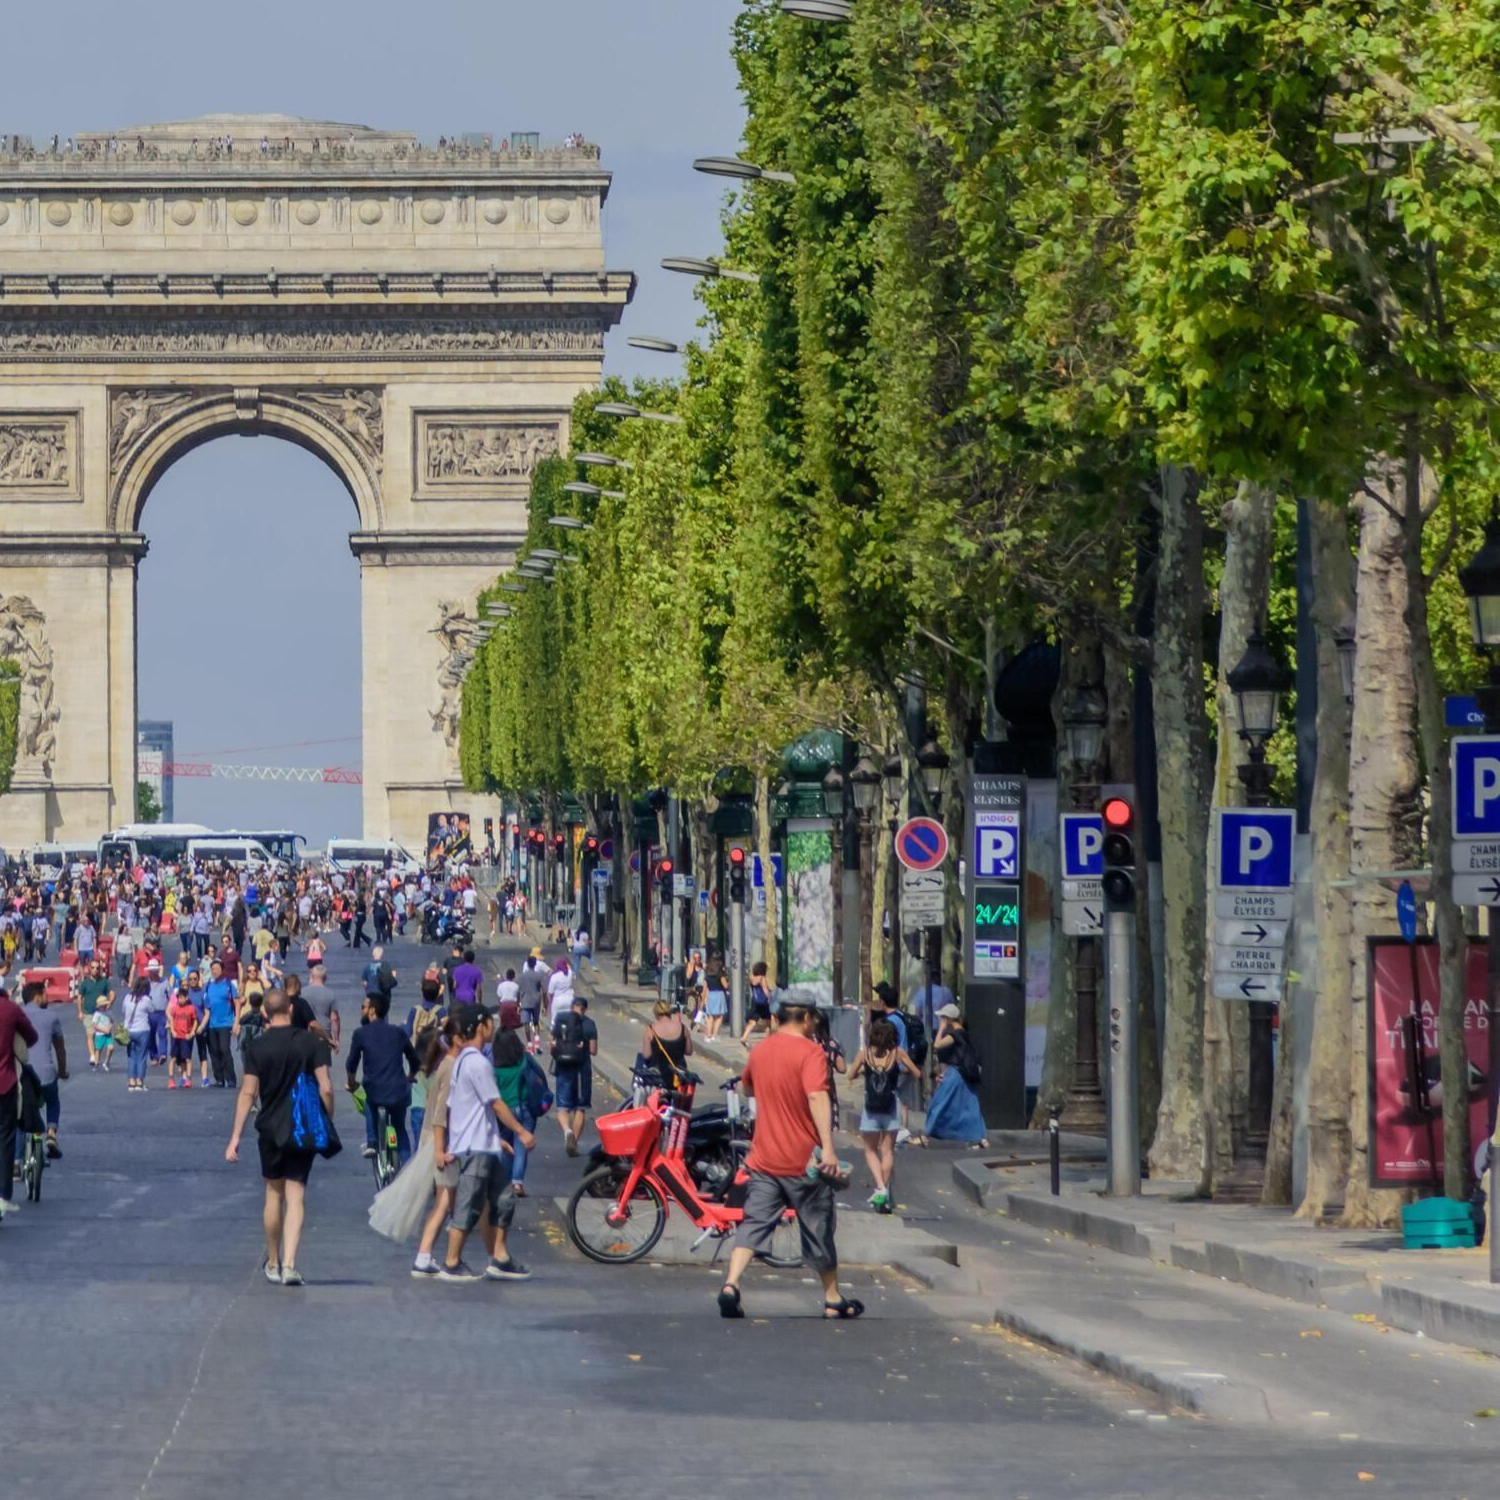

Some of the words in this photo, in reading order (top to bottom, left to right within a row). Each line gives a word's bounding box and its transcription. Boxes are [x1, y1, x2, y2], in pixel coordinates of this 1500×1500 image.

[973, 780, 1021, 790] CHAMPS
[1474, 757, 1500, 819] P
[980, 829, 1015, 875] P
[1077, 826, 1103, 867] P
[1239, 825, 1273, 875] P
[1235, 896, 1275, 906] CHAMPS
[975, 903, 1018, 925] 24/24
[1230, 960, 1276, 970] CHARRON
[1236, 950, 1271, 959] PIERRE
